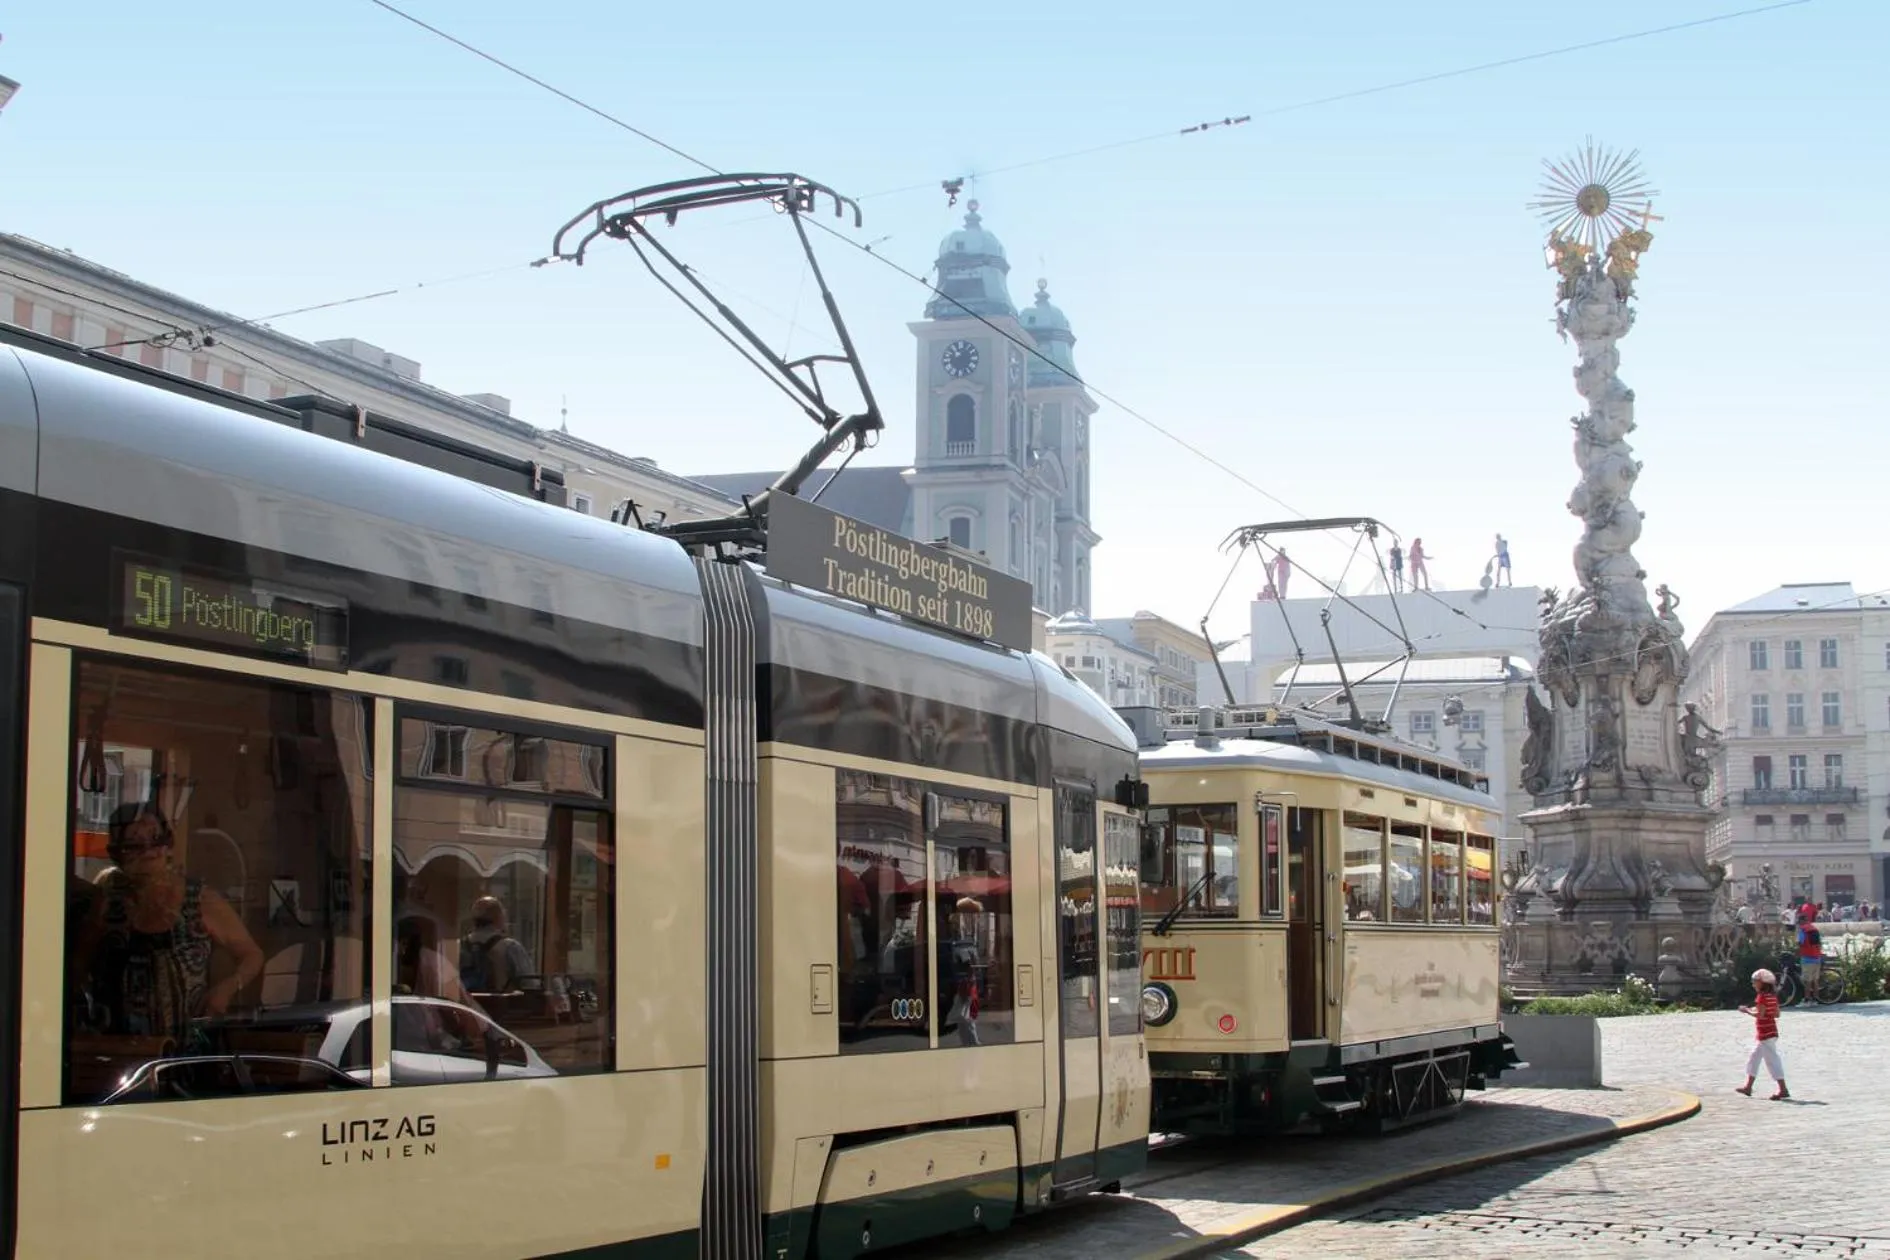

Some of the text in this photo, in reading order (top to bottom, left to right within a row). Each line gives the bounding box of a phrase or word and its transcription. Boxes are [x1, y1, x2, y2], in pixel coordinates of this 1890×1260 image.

[823, 557, 993, 639] Tradition seit 1898
[833, 515, 989, 600] Pöstlingbergbahn
[135, 570, 315, 652] 50 Pöstlingberg
[322, 1115, 435, 1145] LINZ AG
[322, 1143, 436, 1165] LINIEN
